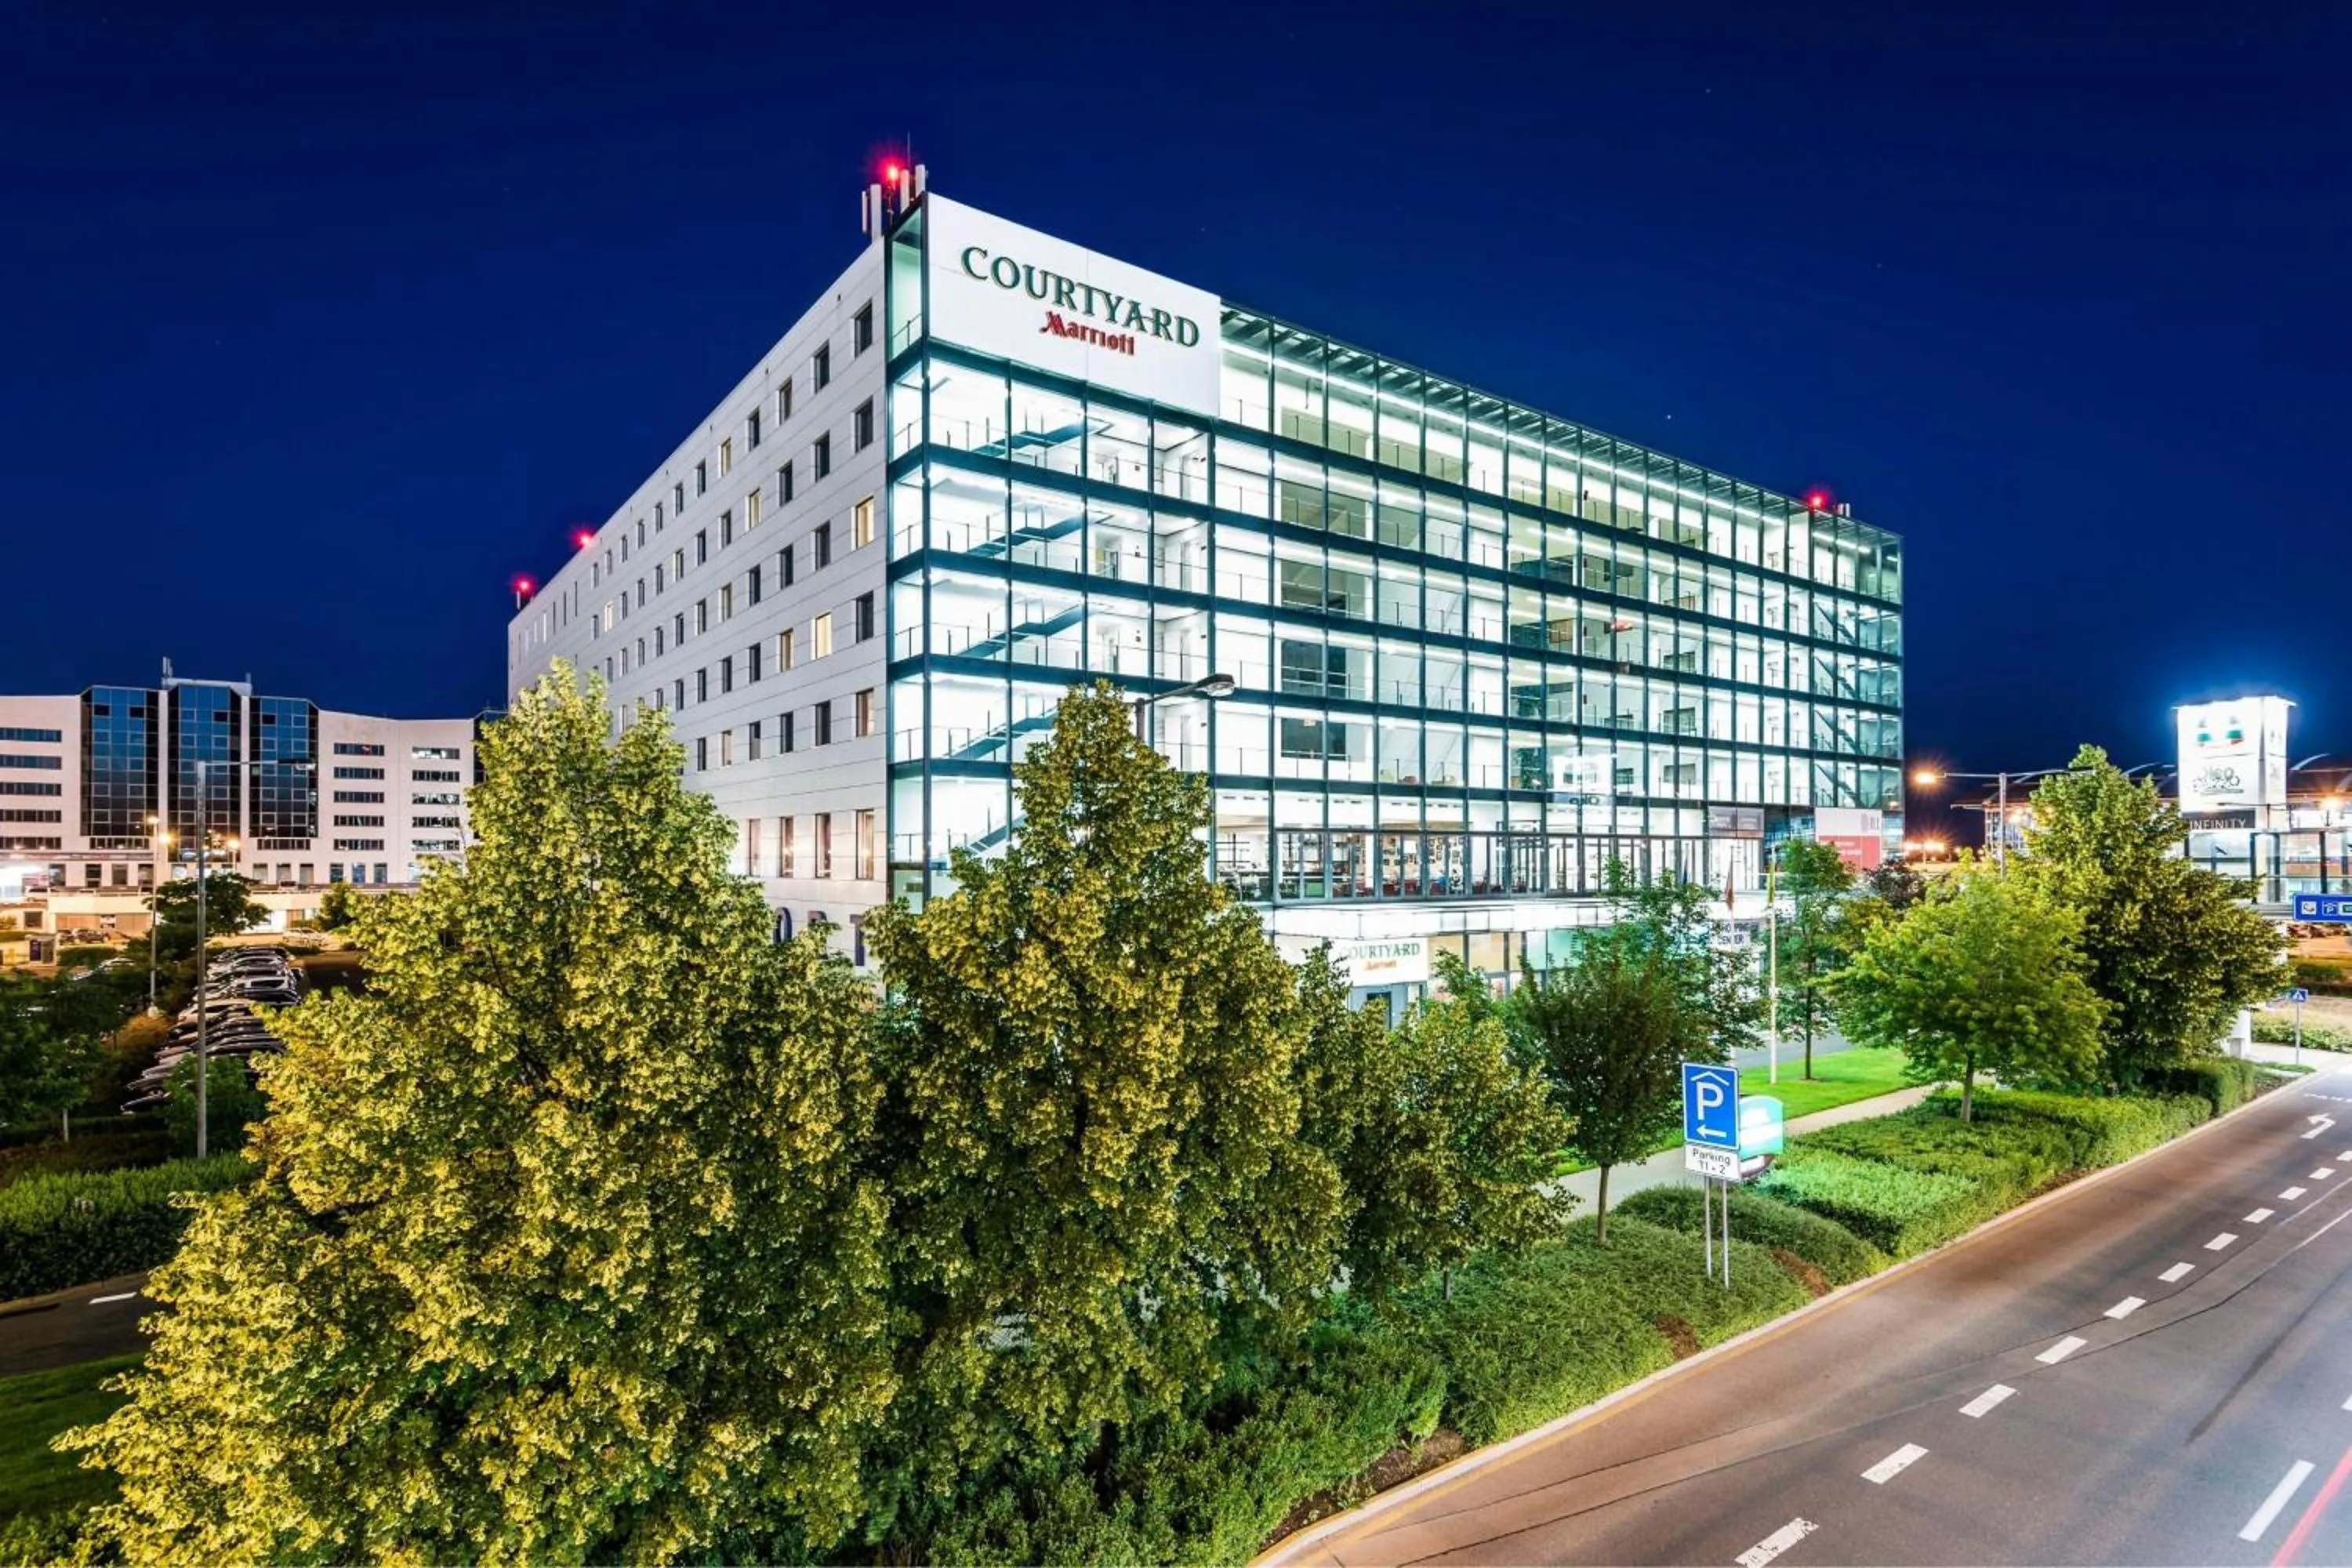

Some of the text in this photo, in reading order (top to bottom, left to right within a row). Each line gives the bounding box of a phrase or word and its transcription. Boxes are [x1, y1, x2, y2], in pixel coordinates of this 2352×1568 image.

[960, 245, 1200, 347] COURTYARD
[1040, 311, 1134, 355] Marriott
[2190, 818, 2246, 829] INFINITY
[1341, 943, 1421, 959] OURTYARD
[1697, 1081, 1723, 1120] P
[1693, 1148, 1730, 1165] Parking
